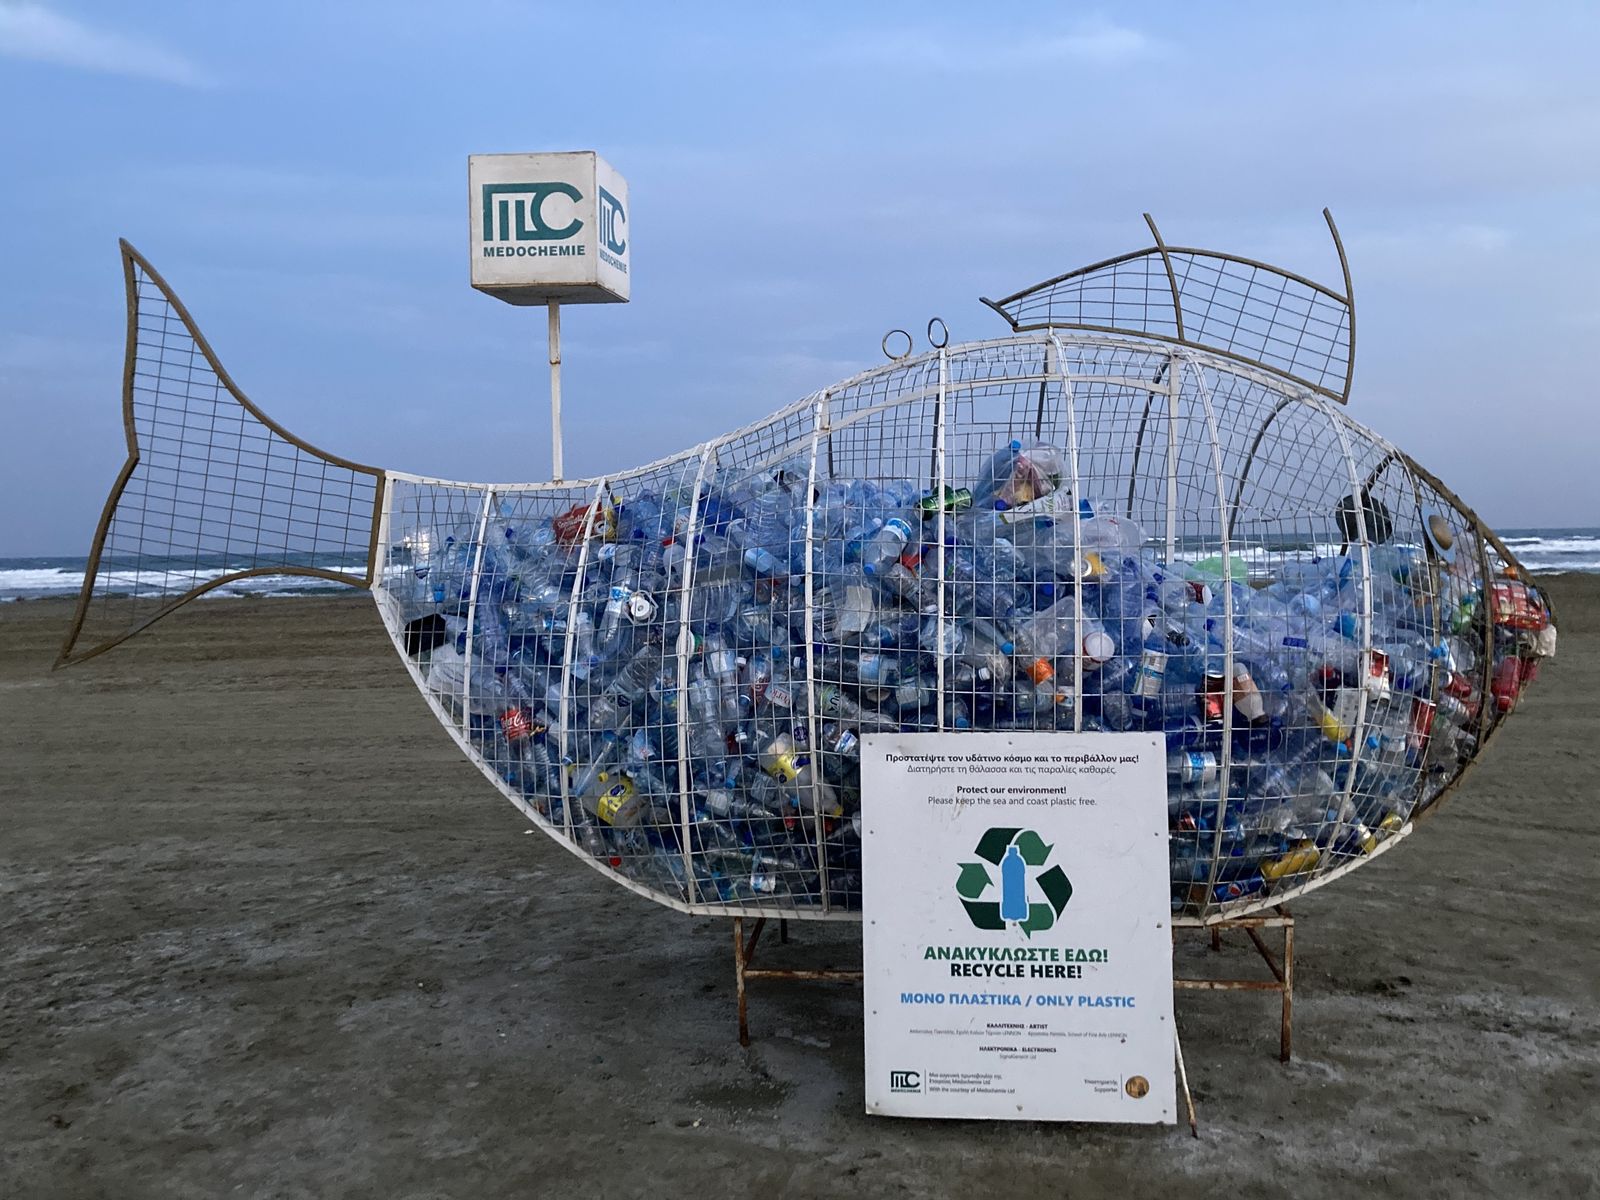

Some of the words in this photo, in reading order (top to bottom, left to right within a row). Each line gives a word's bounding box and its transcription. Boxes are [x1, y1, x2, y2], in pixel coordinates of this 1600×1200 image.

[483, 245, 585, 257] MEDOCHEMIE
[885, 753, 946, 765] Προστατέψτε
[947, 755, 963, 763] τον
[965, 753, 1002, 763] υδάτινο
[1003, 753, 1032, 764] κόσμο
[1034, 755, 1049, 763] και
[1050, 755, 1062, 763] το
[1063, 753, 1118, 765] περιβάλλον
[1119, 754, 1140, 765] μας!
[907, 764, 955, 775] Διατηρήστε
[957, 766, 968, 775] τη
[969, 764, 1007, 774] θάλασσα
[1009, 766, 1023, 774] και
[1024, 766, 1037, 775] τις
[1038, 764, 1078, 775] παραλίες
[956, 785, 989, 795] Protect
[990, 787, 1006, 795] our
[1007, 785, 1067, 795] environment!
[928, 796, 954, 805] Please
[956, 796, 976, 808] keep
[977, 796, 991, 805] the
[992, 798, 1007, 806] sea
[1008, 797, 1025, 806] and
[1026, 797, 1049, 806] coast
[1050, 796, 1077, 808] plastic
[1079, 796, 1098, 806] free.
[924, 946, 1060, 963] ΑΝΑΚΥΚΛΩΣΤΕ
[1064, 948, 1109, 963] ΕΔΩ!
[950, 963, 1025, 978] RECYCLE
[1030, 964, 1082, 979] HERE!
[949, 992, 1022, 1006] ΠΛΑΣΤΙΚΑ
[1025, 994, 1033, 1007] /
[1036, 994, 1074, 1007] ONLY
[1078, 996, 1136, 1008] PLASTIC
